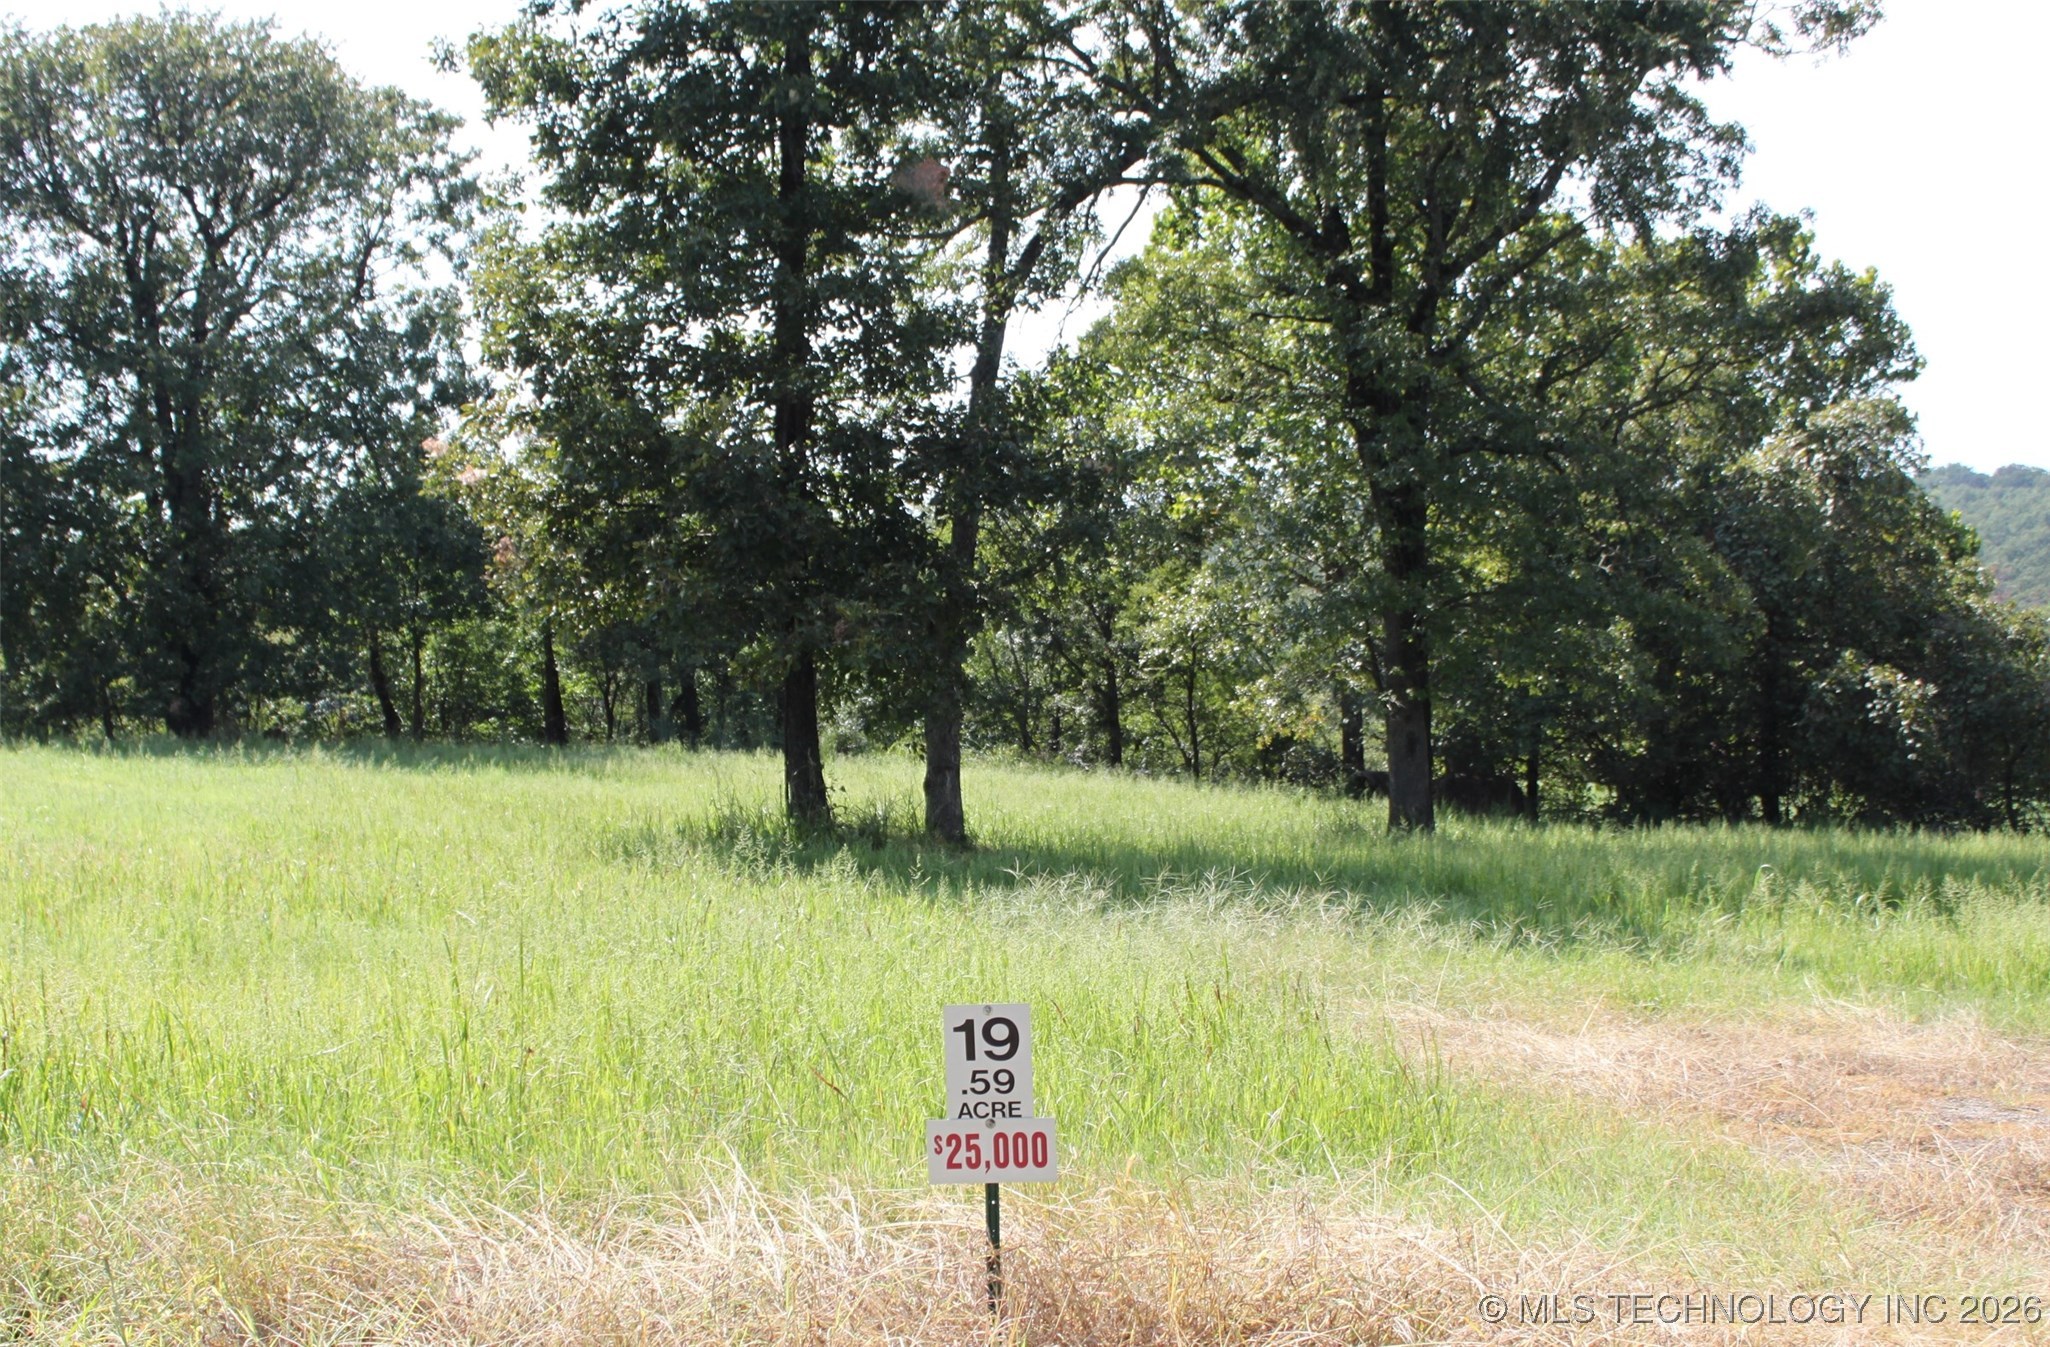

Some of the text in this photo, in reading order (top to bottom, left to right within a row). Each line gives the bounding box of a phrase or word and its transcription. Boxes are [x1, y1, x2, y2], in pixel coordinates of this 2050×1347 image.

[953, 1017, 1019, 1061] 19
[962, 1069, 1015, 1095] .59
[958, 1102, 1022, 1119] ACRE
[934, 1132, 1047, 1173] $25,000
